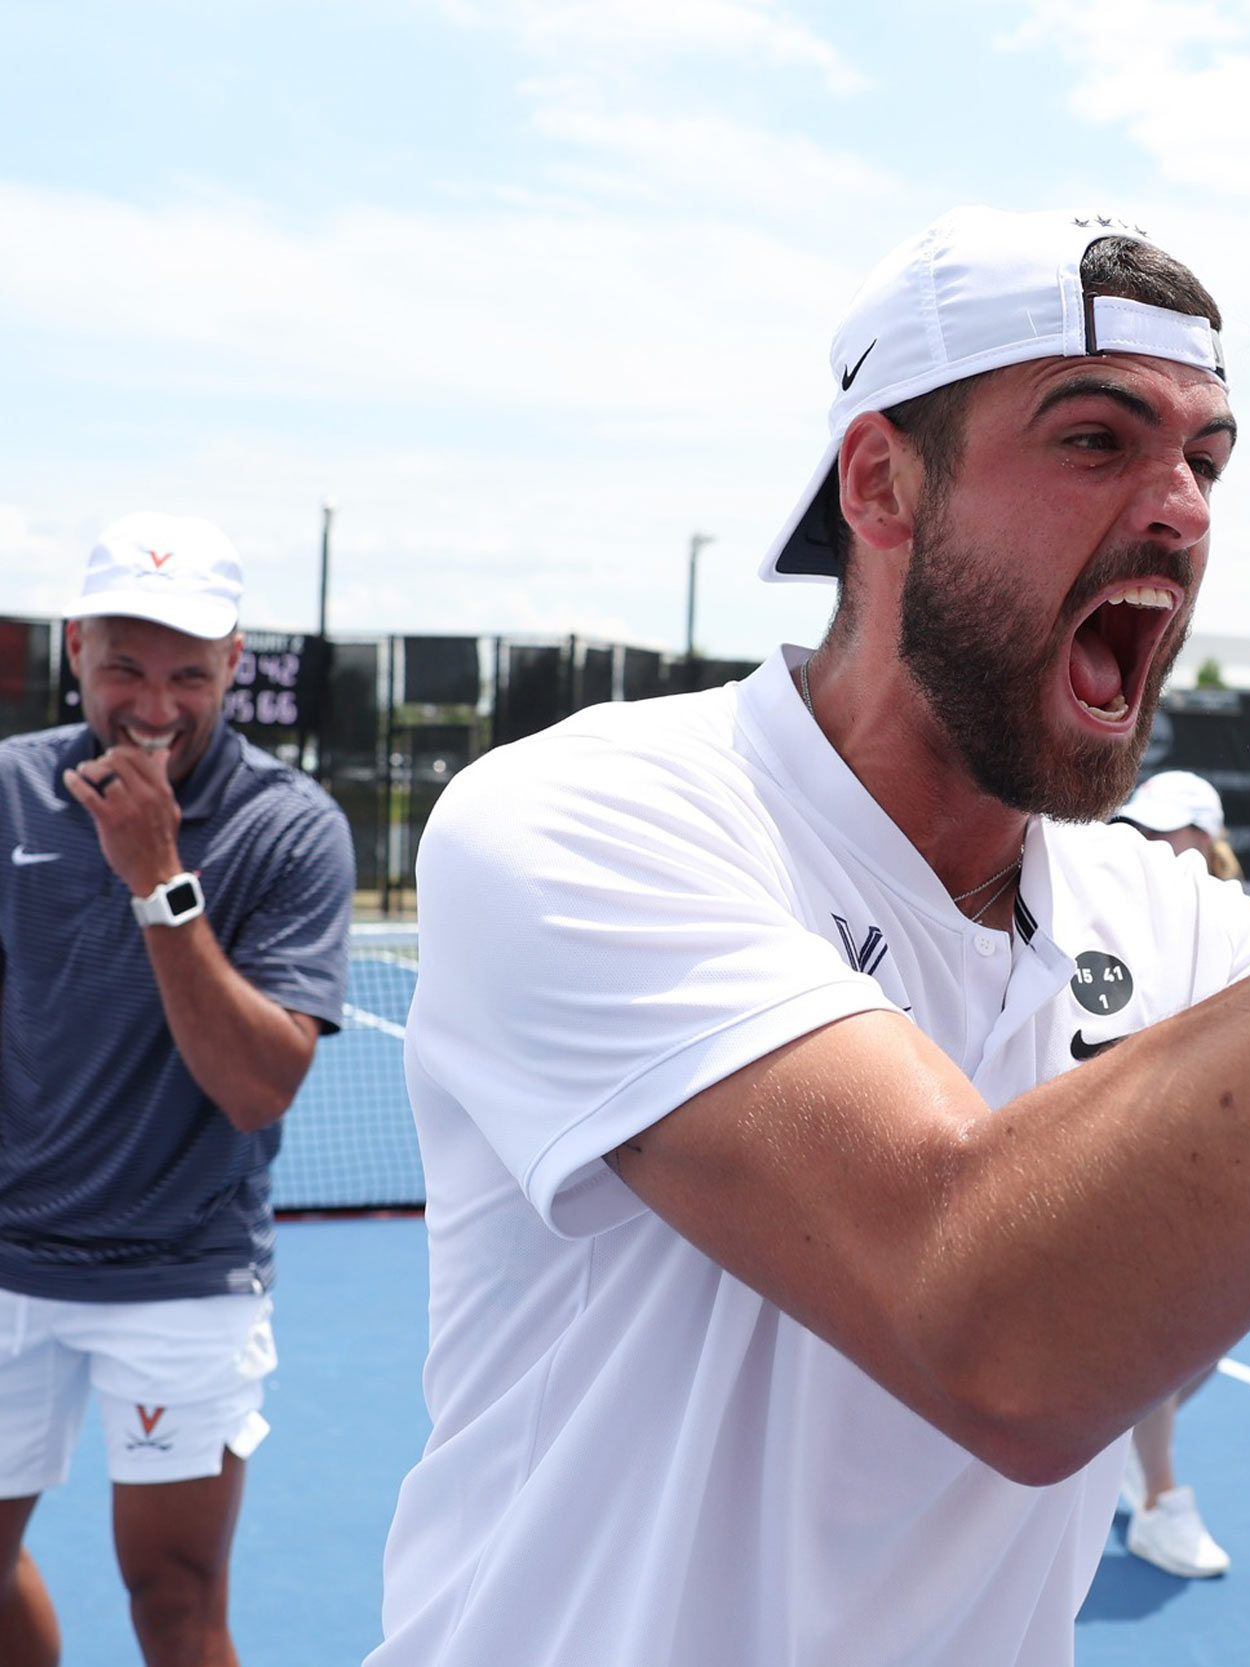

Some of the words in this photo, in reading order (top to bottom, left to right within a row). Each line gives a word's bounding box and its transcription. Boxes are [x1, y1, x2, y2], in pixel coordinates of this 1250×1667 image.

[1076, 968, 1093, 984] 15
[1103, 965, 1124, 983] 41
[1099, 993, 1109, 1009] 1
